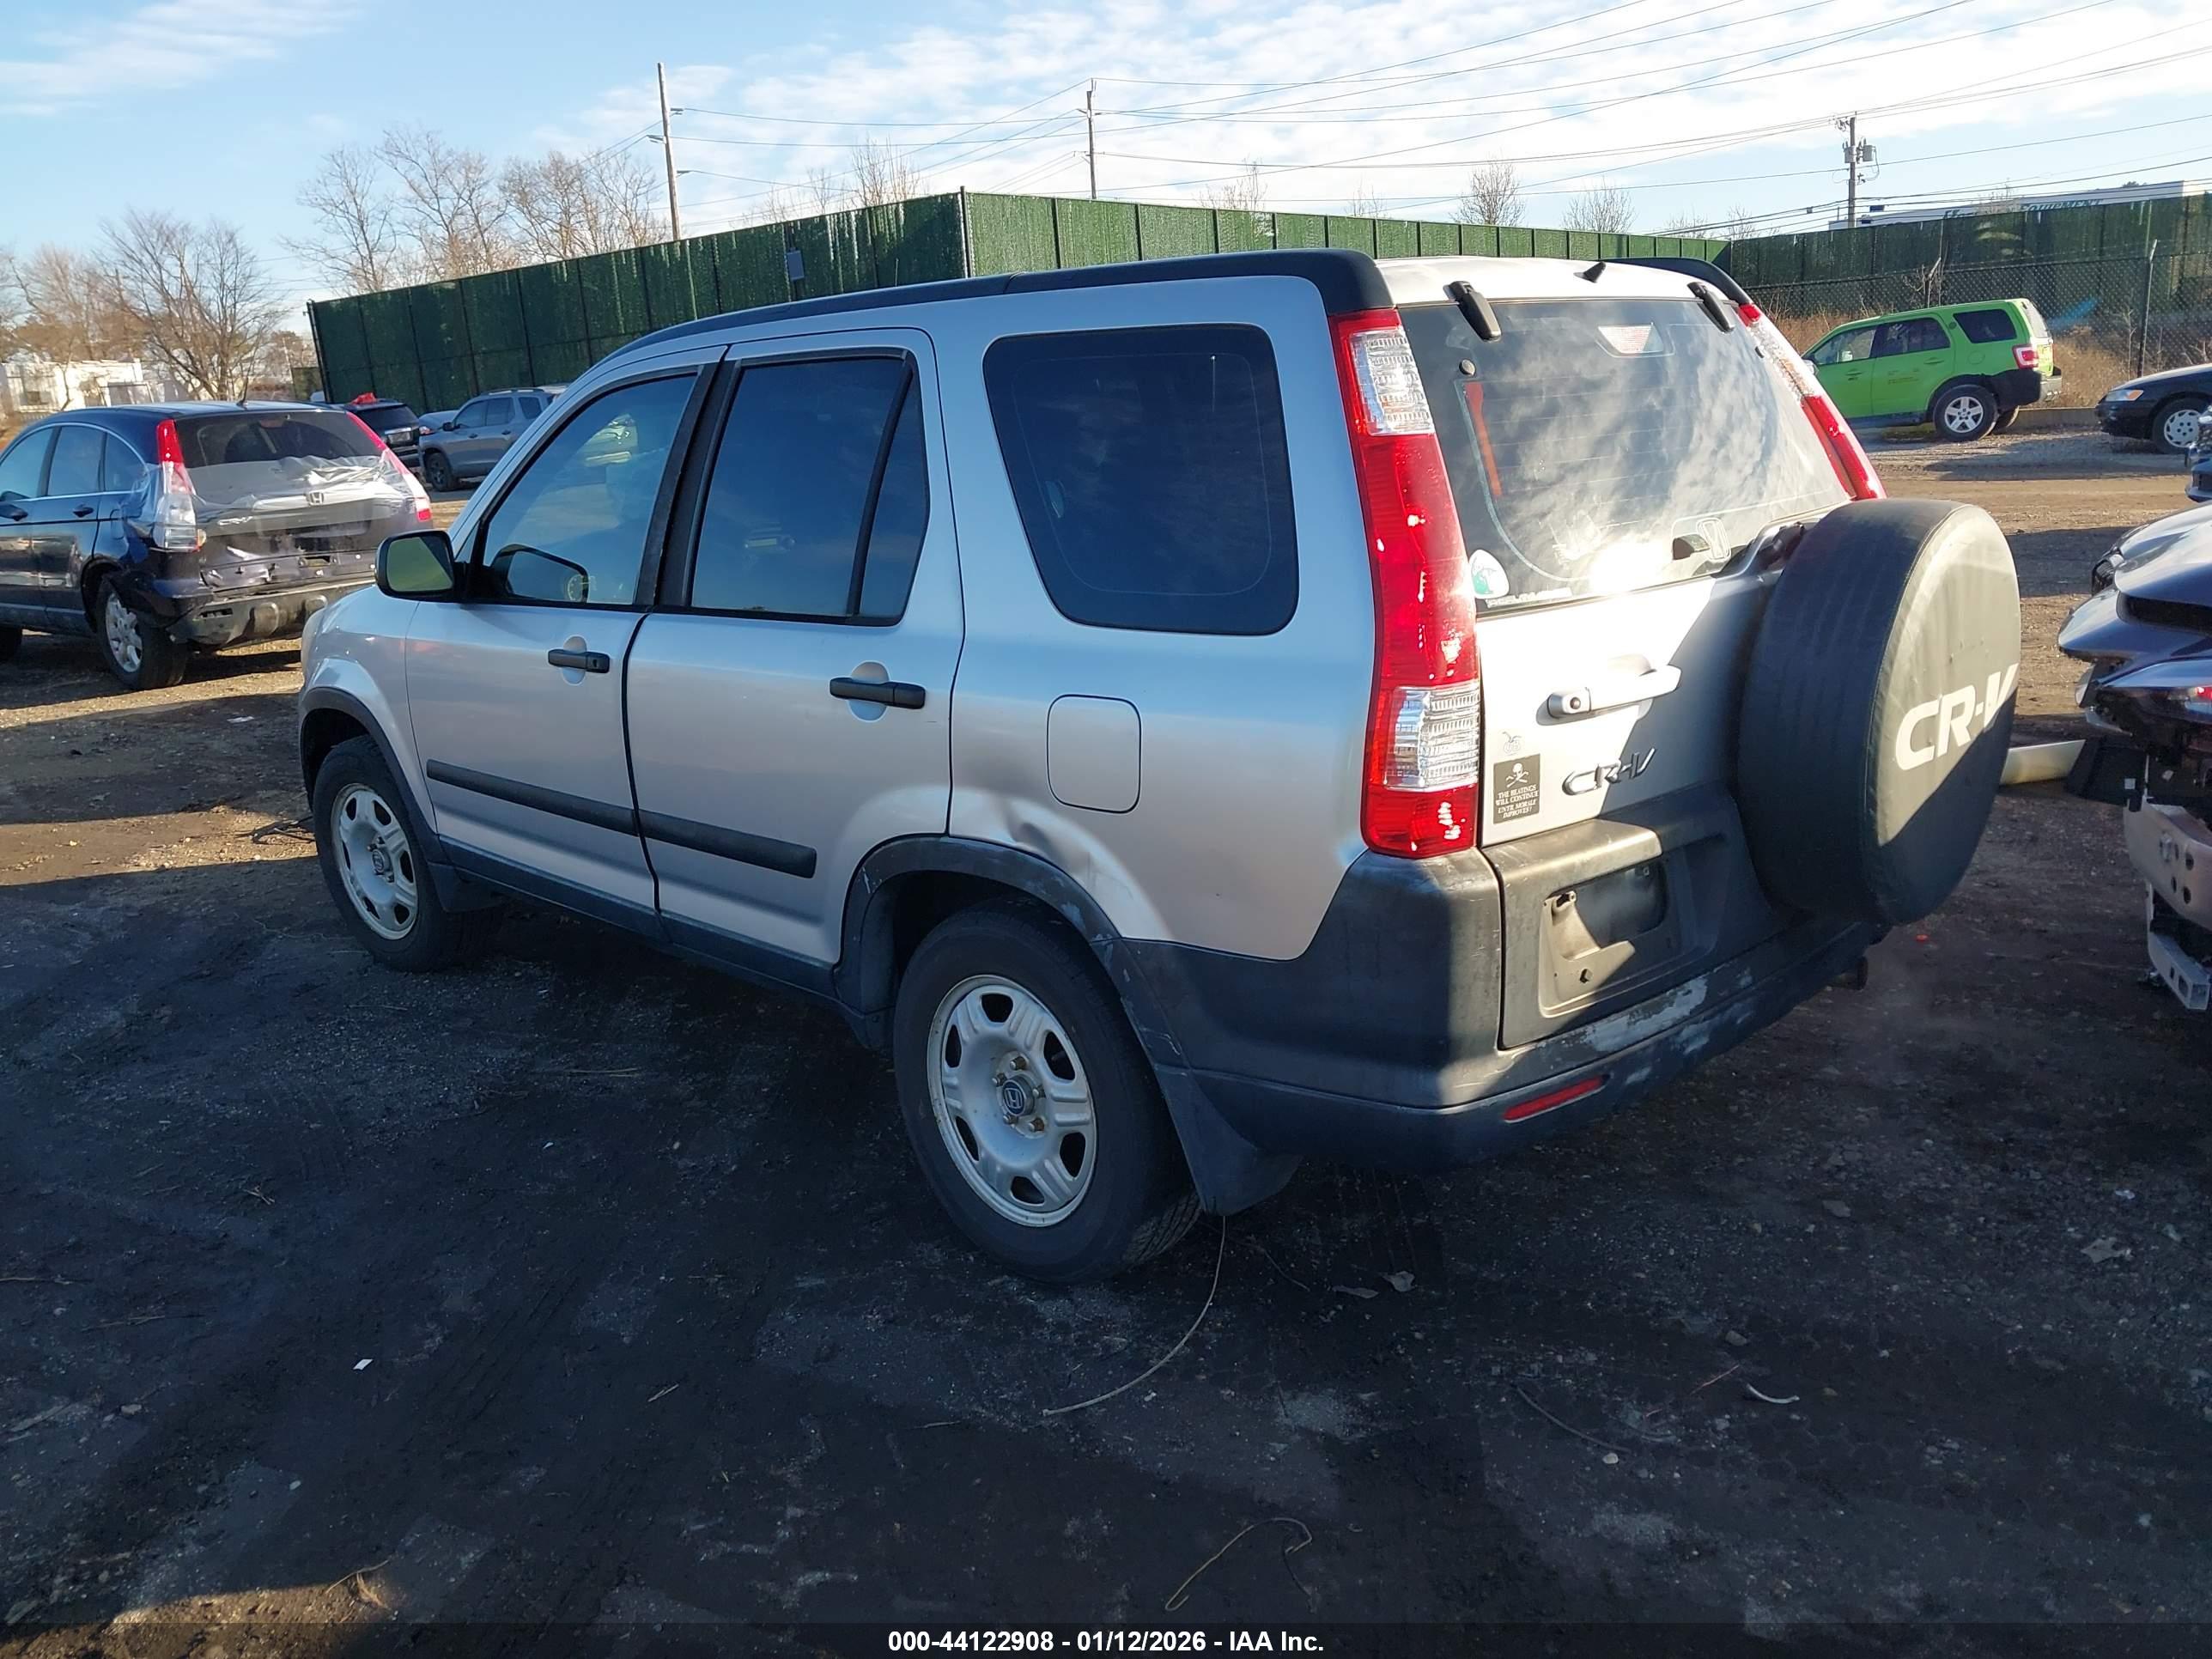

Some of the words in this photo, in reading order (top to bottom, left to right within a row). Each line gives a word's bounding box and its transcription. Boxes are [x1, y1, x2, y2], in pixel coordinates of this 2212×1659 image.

[1896, 662, 2019, 770] CR-V
[1562, 747, 1656, 796] CR-V
[1498, 790, 1510, 799] THE
[1510, 790, 1539, 804] CONTINUE
